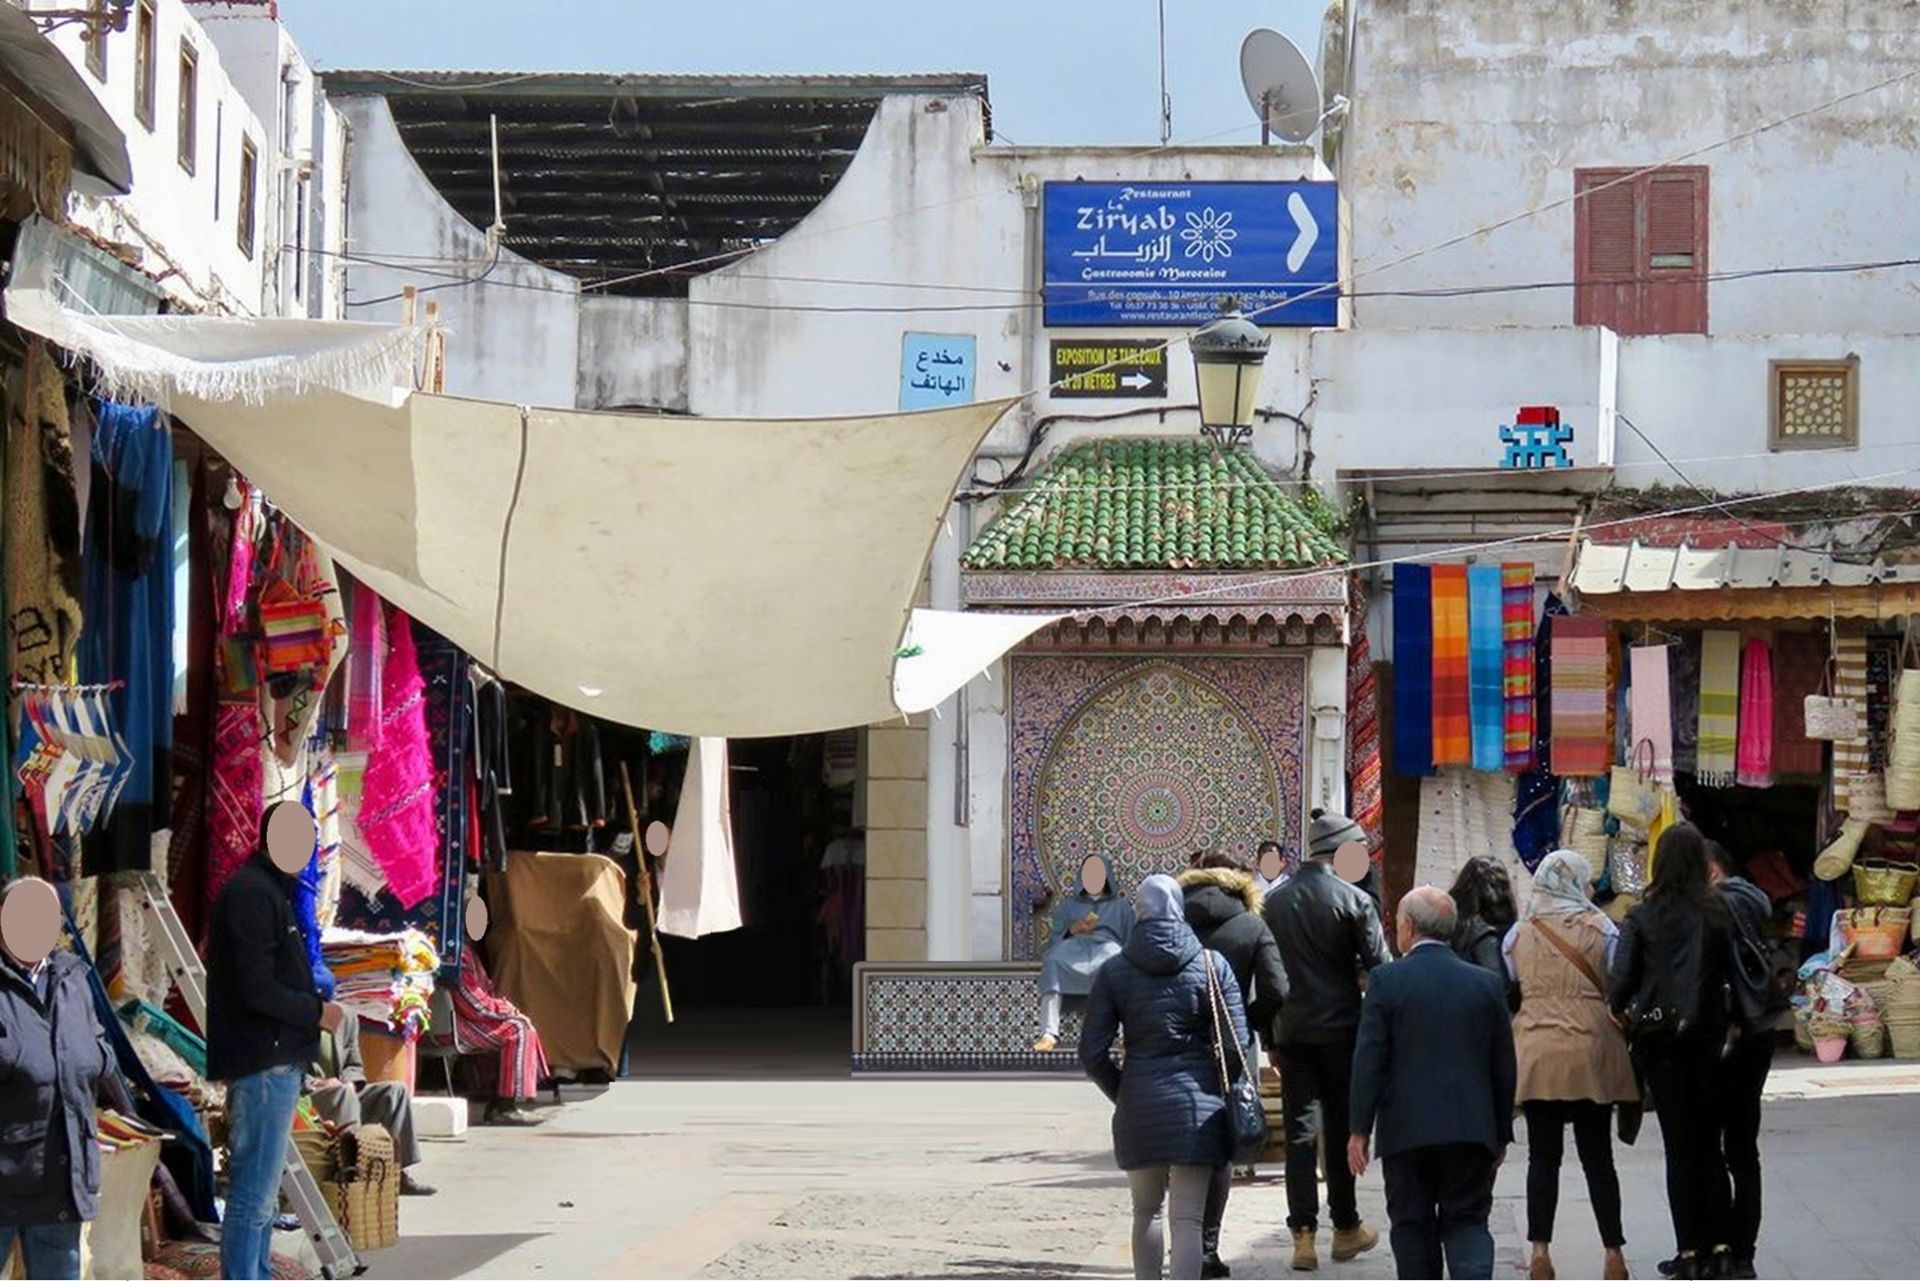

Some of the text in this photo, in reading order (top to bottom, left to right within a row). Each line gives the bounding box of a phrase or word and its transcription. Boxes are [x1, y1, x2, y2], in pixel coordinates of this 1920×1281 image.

[1120, 187, 1191, 201] Restaurant
[1107, 199, 1123, 210] Le
[1076, 205, 1176, 236] Ziryab
[1082, 266, 1227, 281] Gastronomie Marocaine
[916, 349, 963, 373] مخدع
[1056, 348, 1105, 365] EXPOSITION
[1106, 348, 1118, 364] DE
[910, 374, 965, 396] الهاتف
[1084, 373, 1117, 390] METRES
